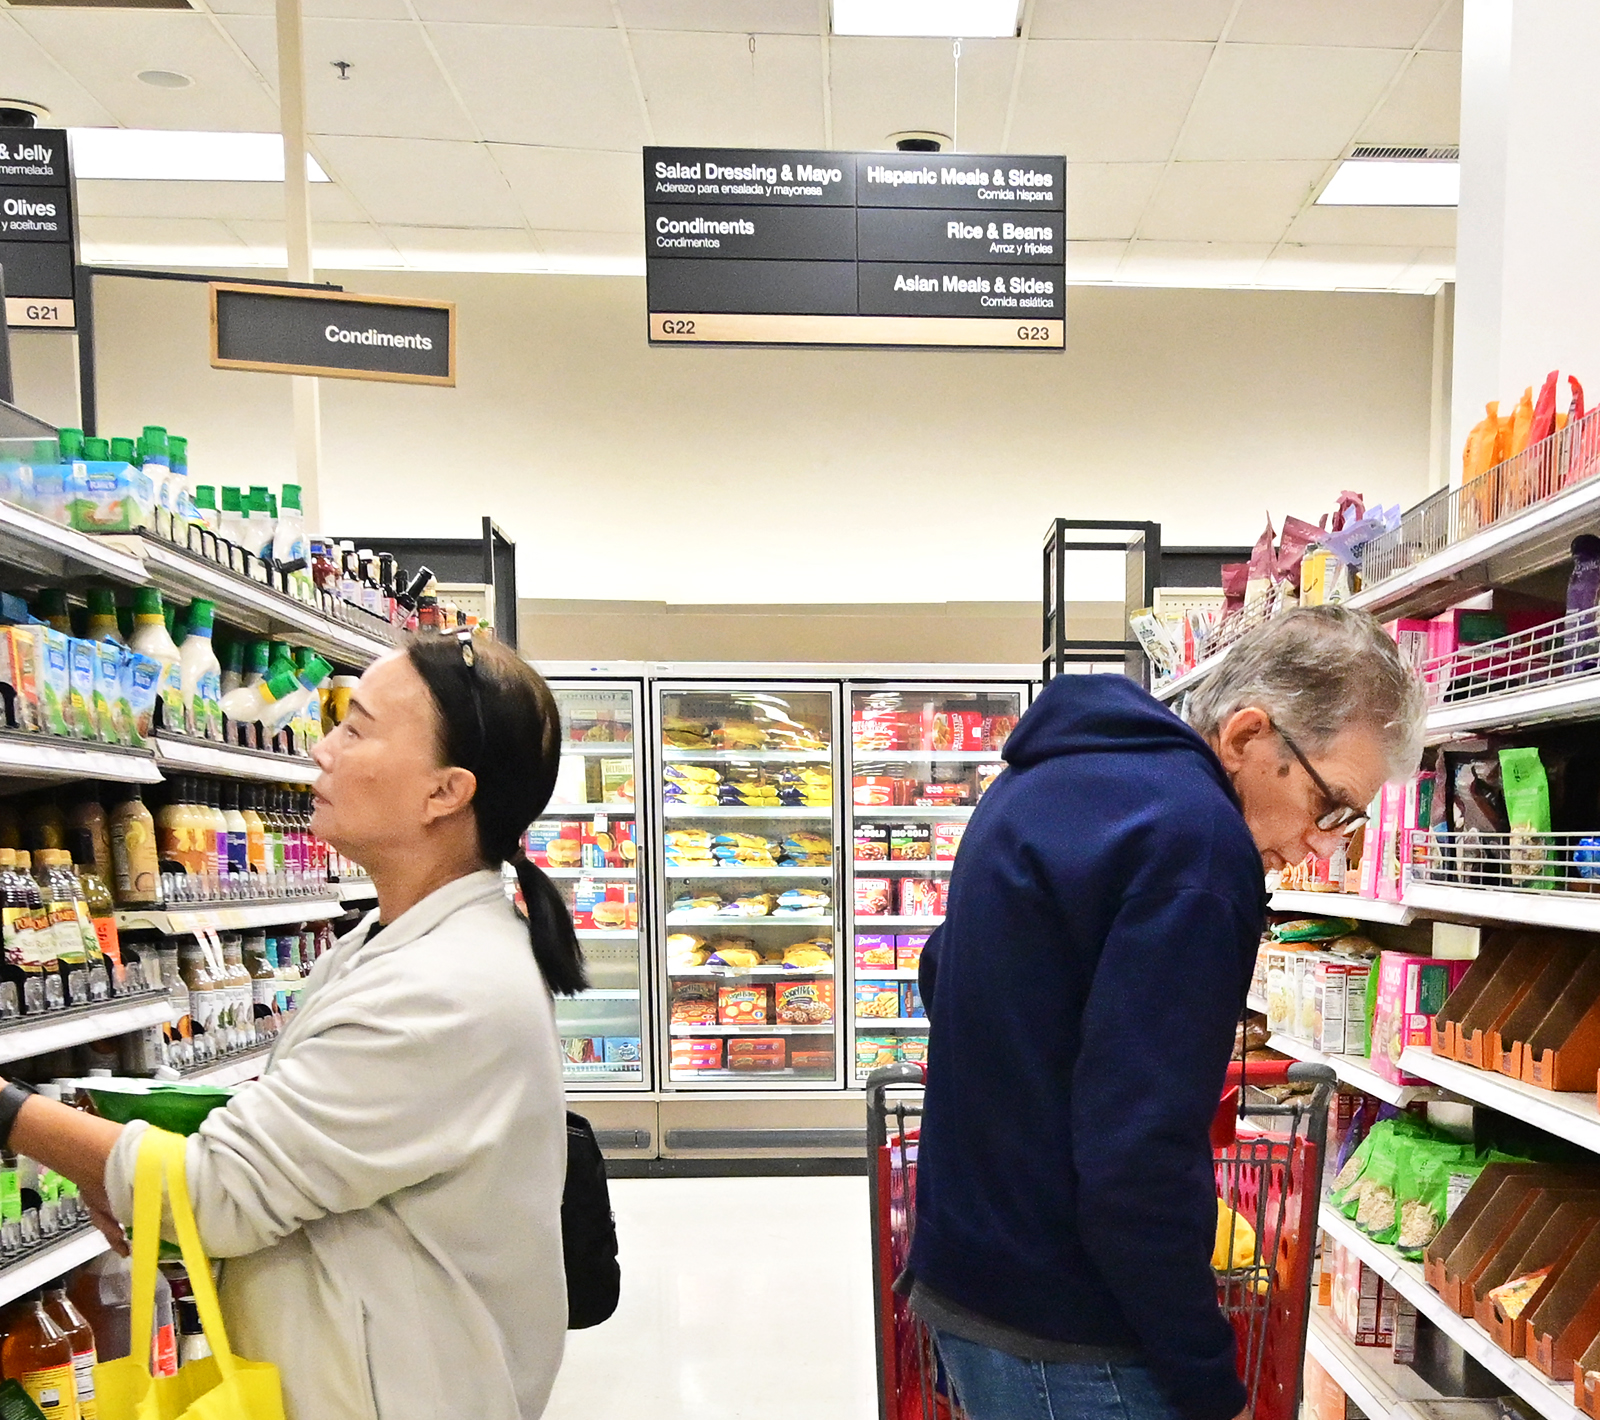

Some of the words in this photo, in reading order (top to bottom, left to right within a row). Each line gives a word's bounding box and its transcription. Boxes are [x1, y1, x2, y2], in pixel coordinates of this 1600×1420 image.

[14, 144, 53, 164] Jelly
[0, 164, 53, 175] mermelada
[655, 162, 701, 180] Salad
[705, 164, 777, 184] Dressing
[780, 165, 794, 182] &
[797, 166, 842, 185] Mayo
[867, 166, 938, 187] Hispanic
[941, 168, 990, 187] Meals
[992, 170, 1005, 187] &
[1008, 170, 1053, 188] Sides
[655, 182, 696, 194] Aderezo
[697, 185, 720, 197] para
[721, 183, 764, 195] ensalada
[765, 187, 772, 197] y
[773, 186, 822, 198] mayonesa
[977, 187, 1014, 200] Comida
[1016, 188, 1053, 202] hispana
[4, 199, 56, 216] Olives
[1, 221, 8, 231] y
[10, 220, 57, 231] aceitunas
[656, 217, 755, 235] Condiments
[947, 221, 985, 240] Rice
[987, 223, 999, 240] &
[1002, 222, 1053, 241] Beans
[656, 237, 720, 249] Condimentos
[989, 242, 1014, 254] Arroz
[1016, 246, 1022, 256] y
[1024, 242, 1053, 256] frijoles
[894, 275, 939, 292] Asian
[942, 276, 991, 293] Meals
[993, 277, 1006, 293] &
[1009, 277, 1054, 294] Sides
[980, 295, 1016, 307] Comida
[1018, 296, 1054, 308] asiática
[26, 305, 58, 320] G21
[662, 319, 696, 335] G22
[1017, 325, 1050, 341] G23
[324, 324, 433, 352] Condiments
